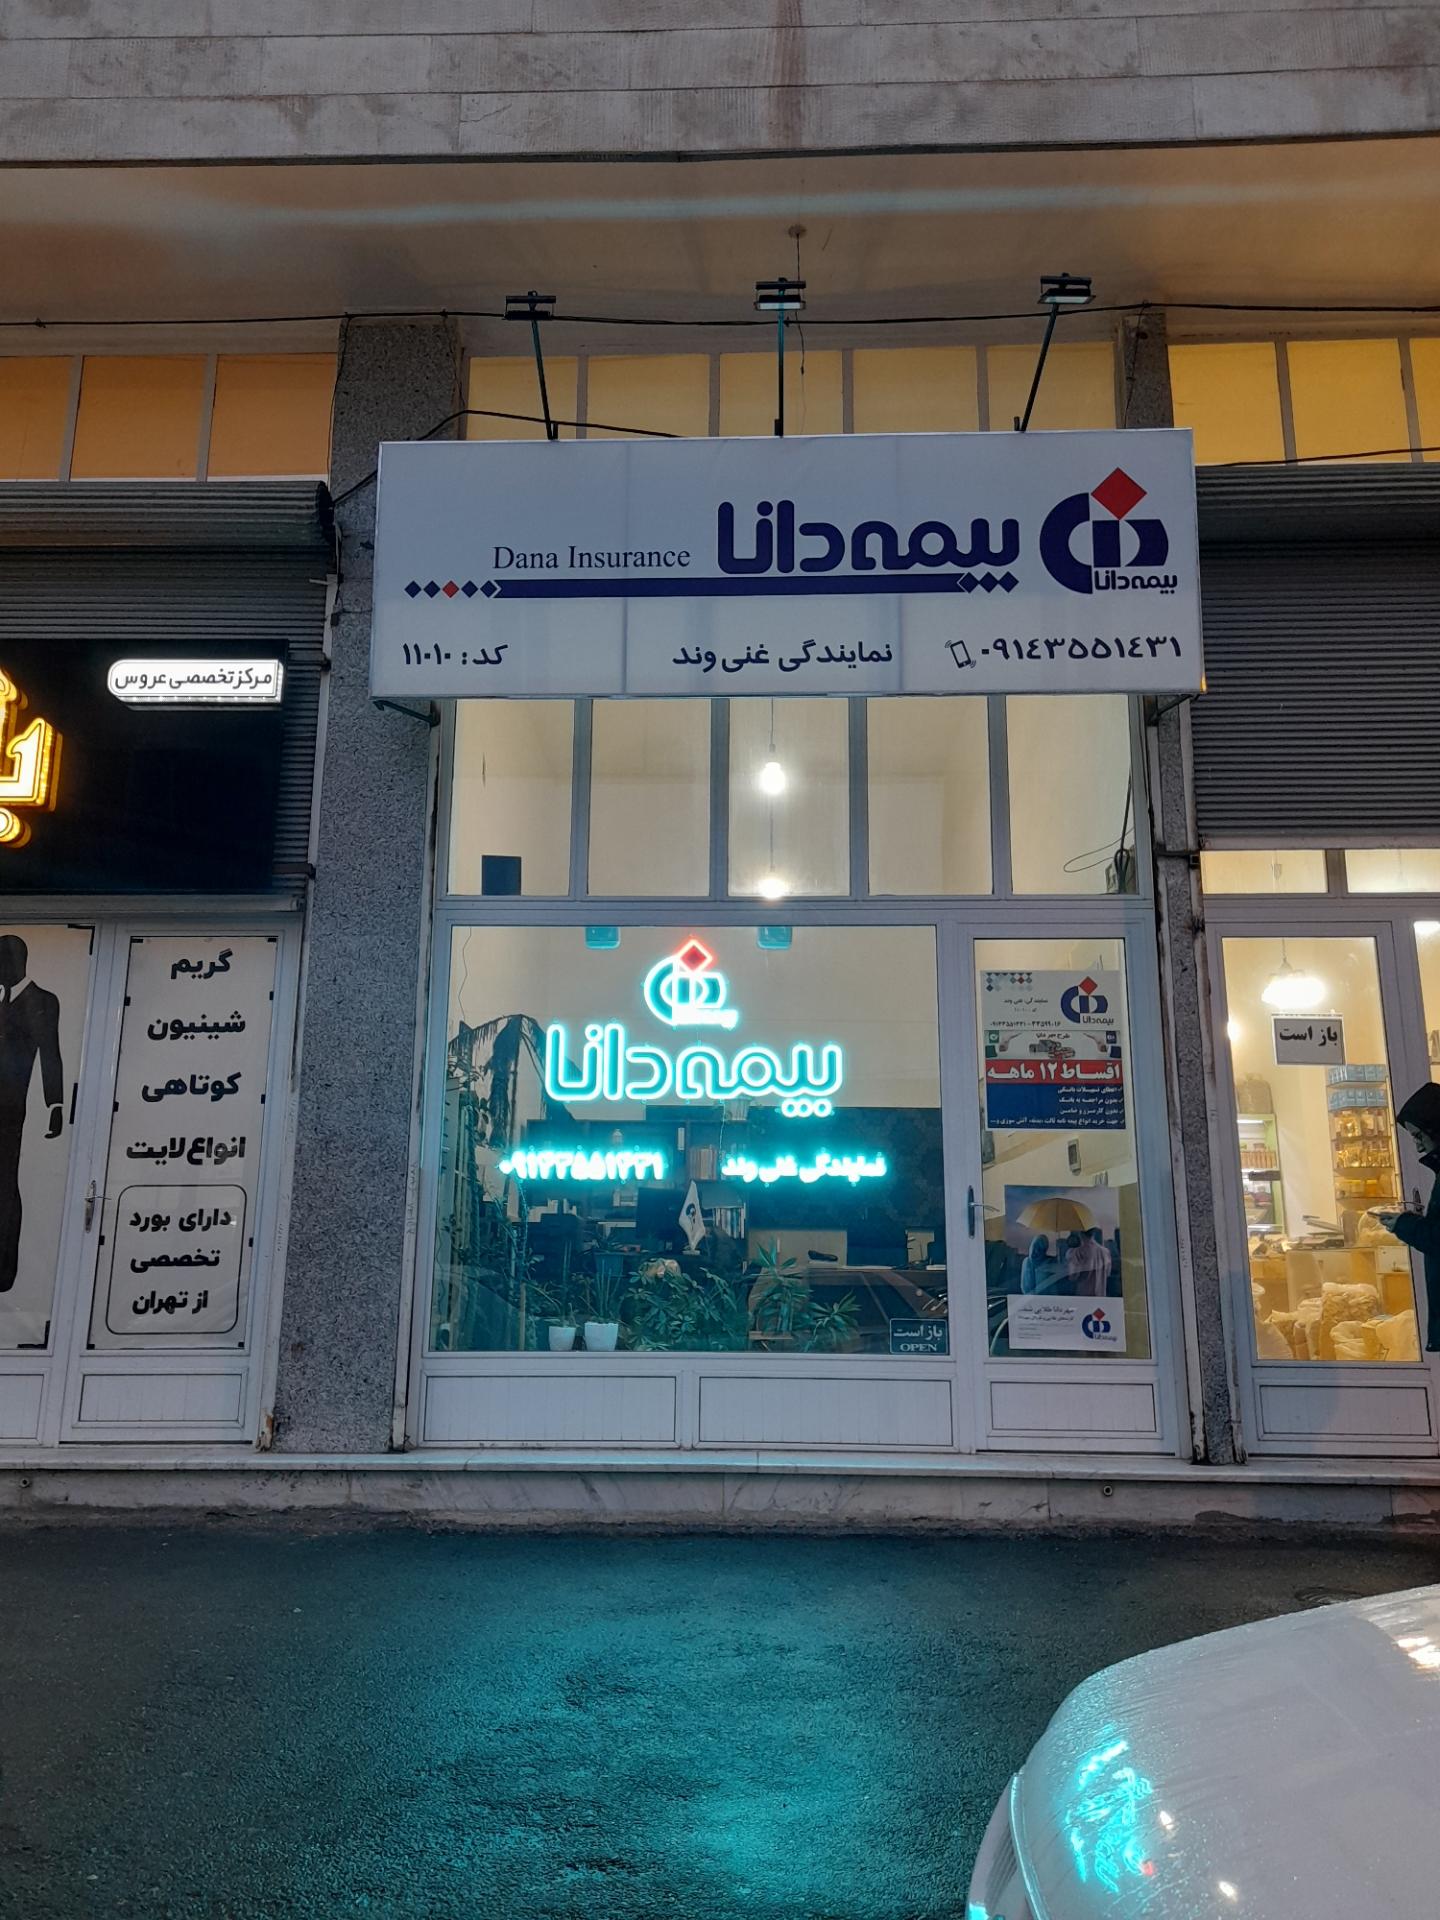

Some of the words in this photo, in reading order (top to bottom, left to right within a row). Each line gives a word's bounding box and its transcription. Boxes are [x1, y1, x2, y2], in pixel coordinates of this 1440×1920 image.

[493, 546, 559, 569] Dana
[568, 545, 691, 569] Insurance
[779, 639, 893, 673] نمایندگی
[114, 673, 168, 690] عروس
[168, 668, 234, 690] تخصصی
[232, 667, 273, 690] مرکز
[170, 948, 234, 980] گریم
[147, 1010, 247, 1041] شینیون
[1279, 1025, 1314, 1042] است
[1318, 1025, 1338, 1047] باز
[987, 1063, 1035, 1080] ماهه
[1040, 1062, 1058, 1080] ۱۲
[1061, 1062, 1120, 1080] اقساط
[141, 1071, 242, 1103] کوتاهی
[126, 1136, 187, 1166] لایت
[187, 1136, 248, 1166] انواع
[128, 1211, 171, 1234] بورد
[178, 1208, 232, 1234] دارای
[130, 1247, 221, 1274] تخصصی
[131, 1290, 189, 1315] تهران
[191, 1290, 209, 1315] از
[893, 1324, 924, 1338] است
[925, 1324, 943, 1341] باز
[899, 1343, 938, 1352] OPEN
